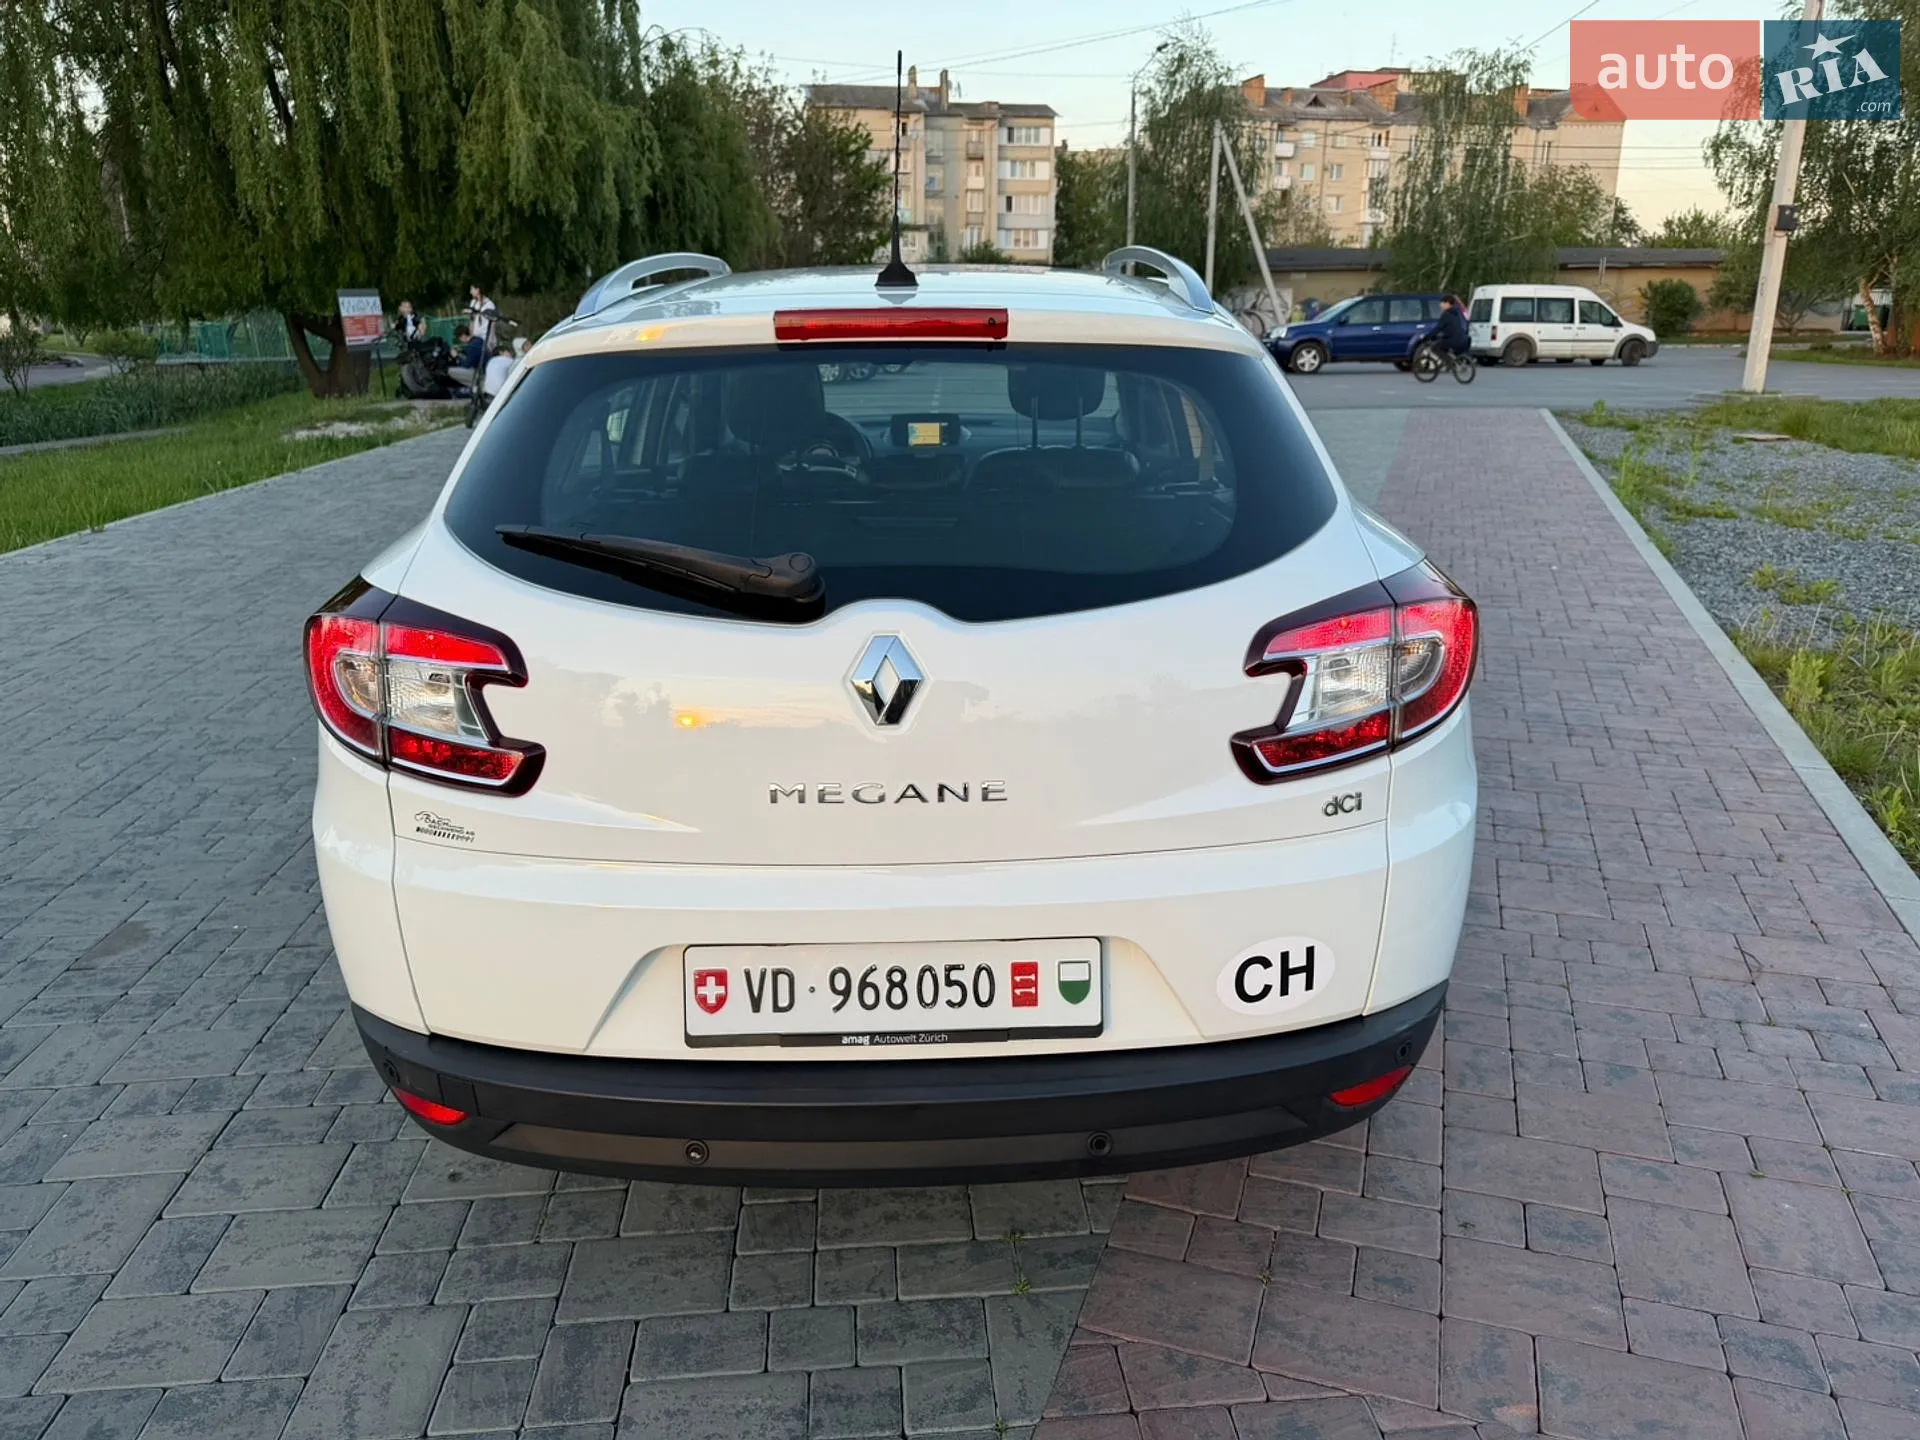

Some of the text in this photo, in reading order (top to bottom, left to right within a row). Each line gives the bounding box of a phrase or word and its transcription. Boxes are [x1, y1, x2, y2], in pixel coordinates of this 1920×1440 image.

[768, 780, 1008, 804] MEGANE
[743, 963, 996, 1014] VD 968050
[1234, 945, 1316, 1004] CH
[841, 1033, 948, 1046] amag Autowelt Zürich
